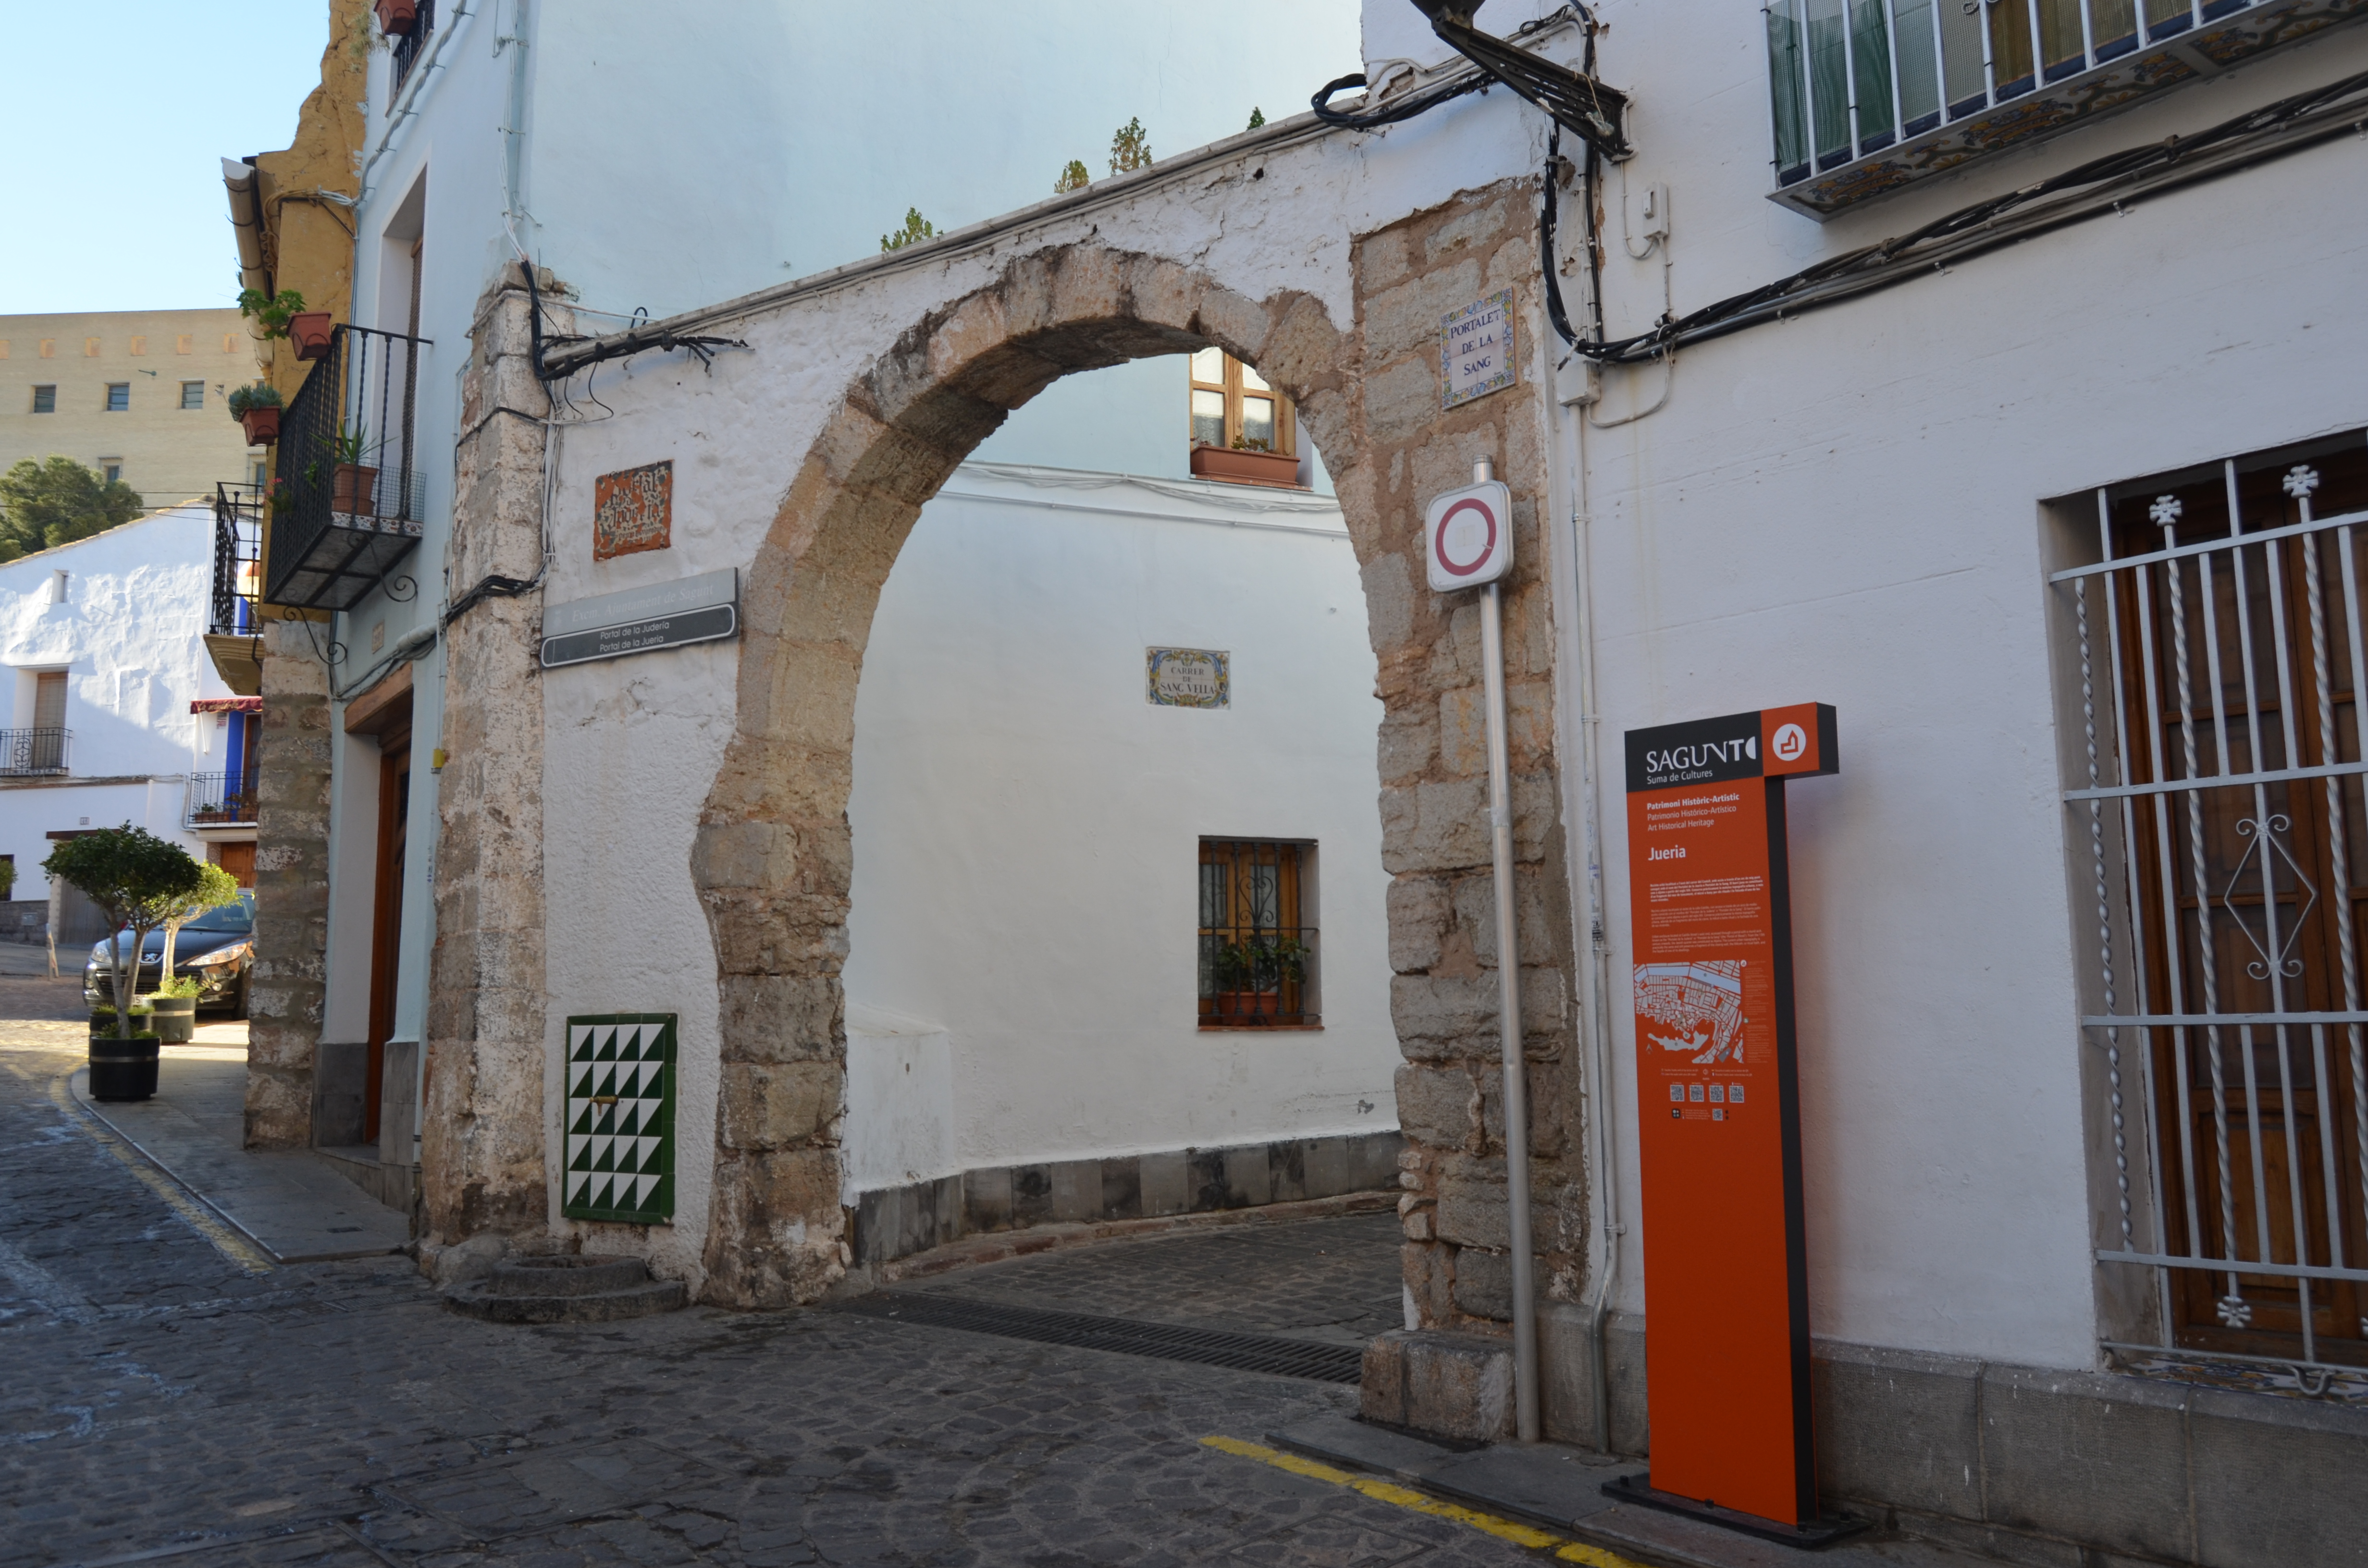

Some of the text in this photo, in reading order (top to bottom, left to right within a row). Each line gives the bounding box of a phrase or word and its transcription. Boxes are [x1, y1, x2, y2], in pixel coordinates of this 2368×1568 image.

[1451, 309, 1501, 339] PORTALET
[1462, 334, 1493, 355] DE LA
[1464, 356, 1491, 376] SANG
[604, 595, 661, 617] Ajuntament
[665, 591, 675, 603] de
[679, 585, 713, 600] Sagunt
[601, 621, 669, 640] Portal de la Judería
[600, 635, 664, 652] Portal de la Jueria
[1171, 667, 1204, 675] CARRER
[1160, 682, 1214, 694] SANG VELLA
[1647, 769, 1713, 784] Suma de Cultures
[1647, 793, 1739, 810] Patrimoni Històric-Artístic
[1647, 805, 1737, 821] Patrimonio Histórico-Artístico
[1648, 819, 1714, 832] Art Historical Heritage
[1648, 845, 1686, 861] Jueria
